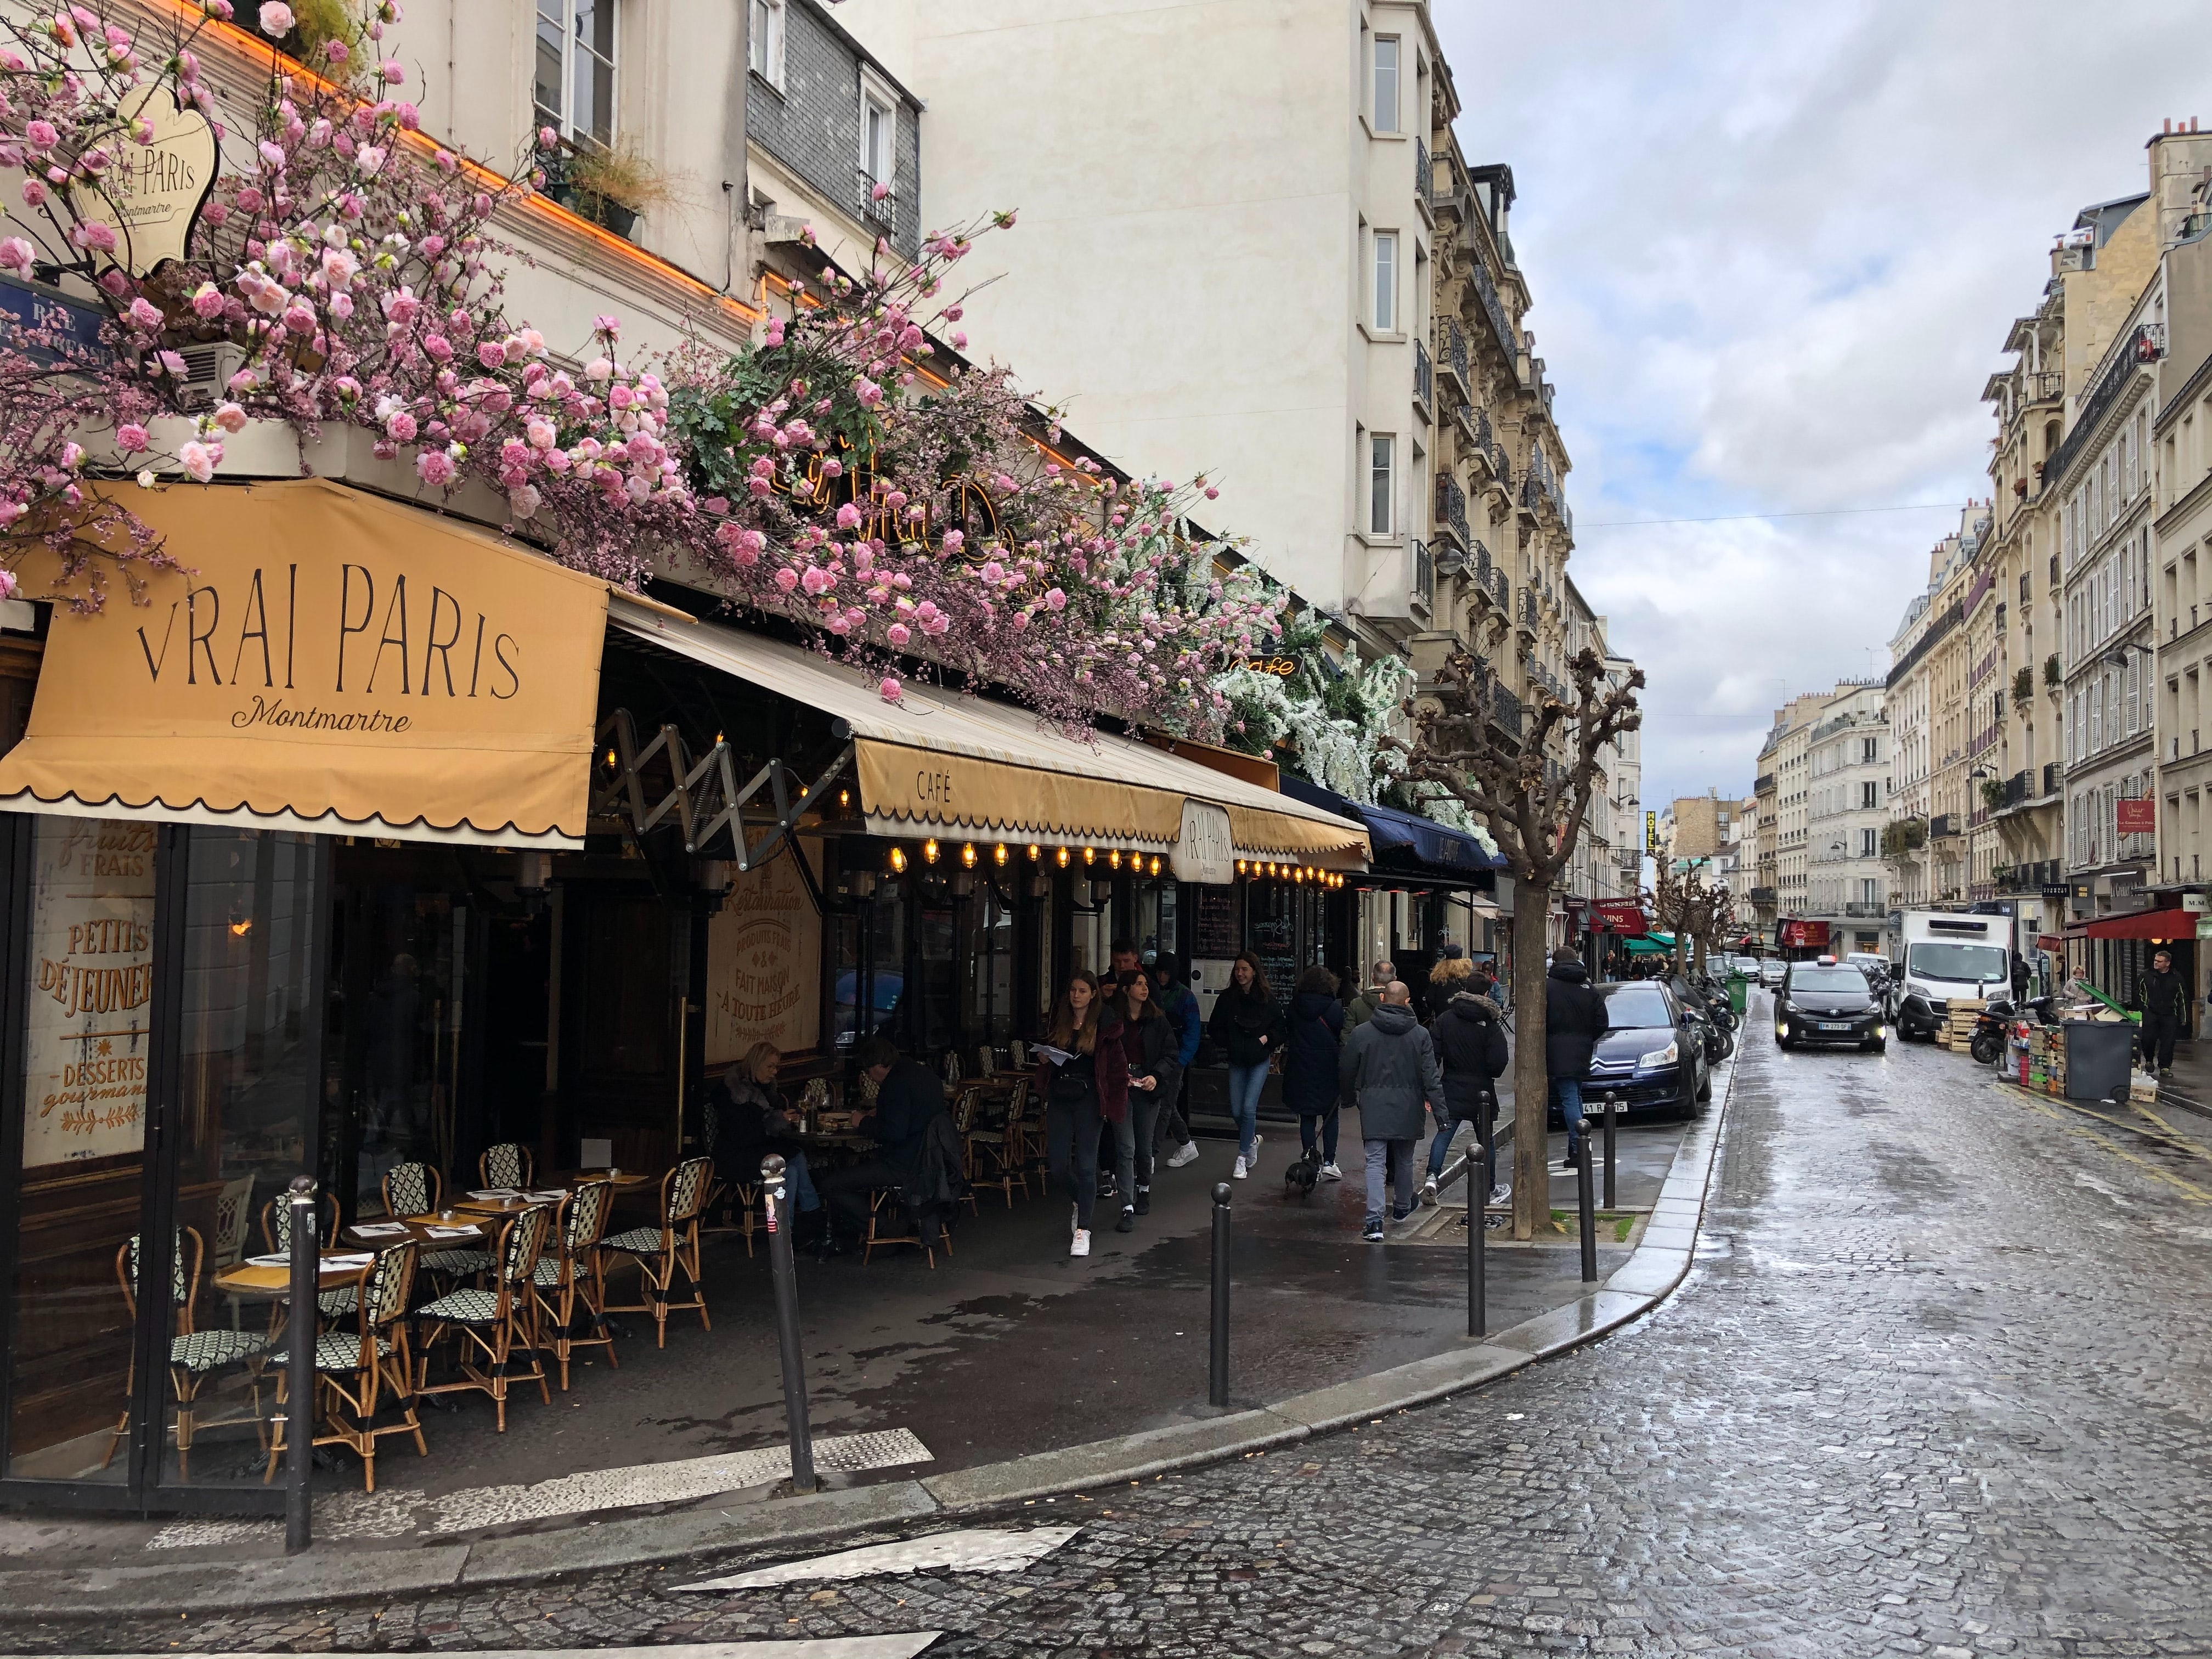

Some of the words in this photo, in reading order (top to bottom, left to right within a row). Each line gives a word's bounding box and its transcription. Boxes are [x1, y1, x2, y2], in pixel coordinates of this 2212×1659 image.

[144, 149, 194, 195] PARIS
[137, 563, 297, 689] VRAI
[335, 564, 520, 699] PARIS
[232, 695, 413, 733] Montmartre
[917, 769, 951, 803] CAFÉ
[1206, 811, 1229, 862] PARIS
[79, 853, 144, 877] FRAIS
[725, 879, 804, 916] Restauration
[67, 918, 149, 954] PETITS
[736, 930, 771, 957] PRODUITS
[772, 932, 792, 953] FRAIS
[760, 950, 768, 968] &
[736, 968, 756, 995] FAIT
[757, 964, 789, 995] MAISON
[732, 996, 767, 1022] TOUTE
[769, 983, 800, 1019] HEURE
[63, 1057, 145, 1087] DESSERTS
[1614, 1103, 1624, 1111] 75
